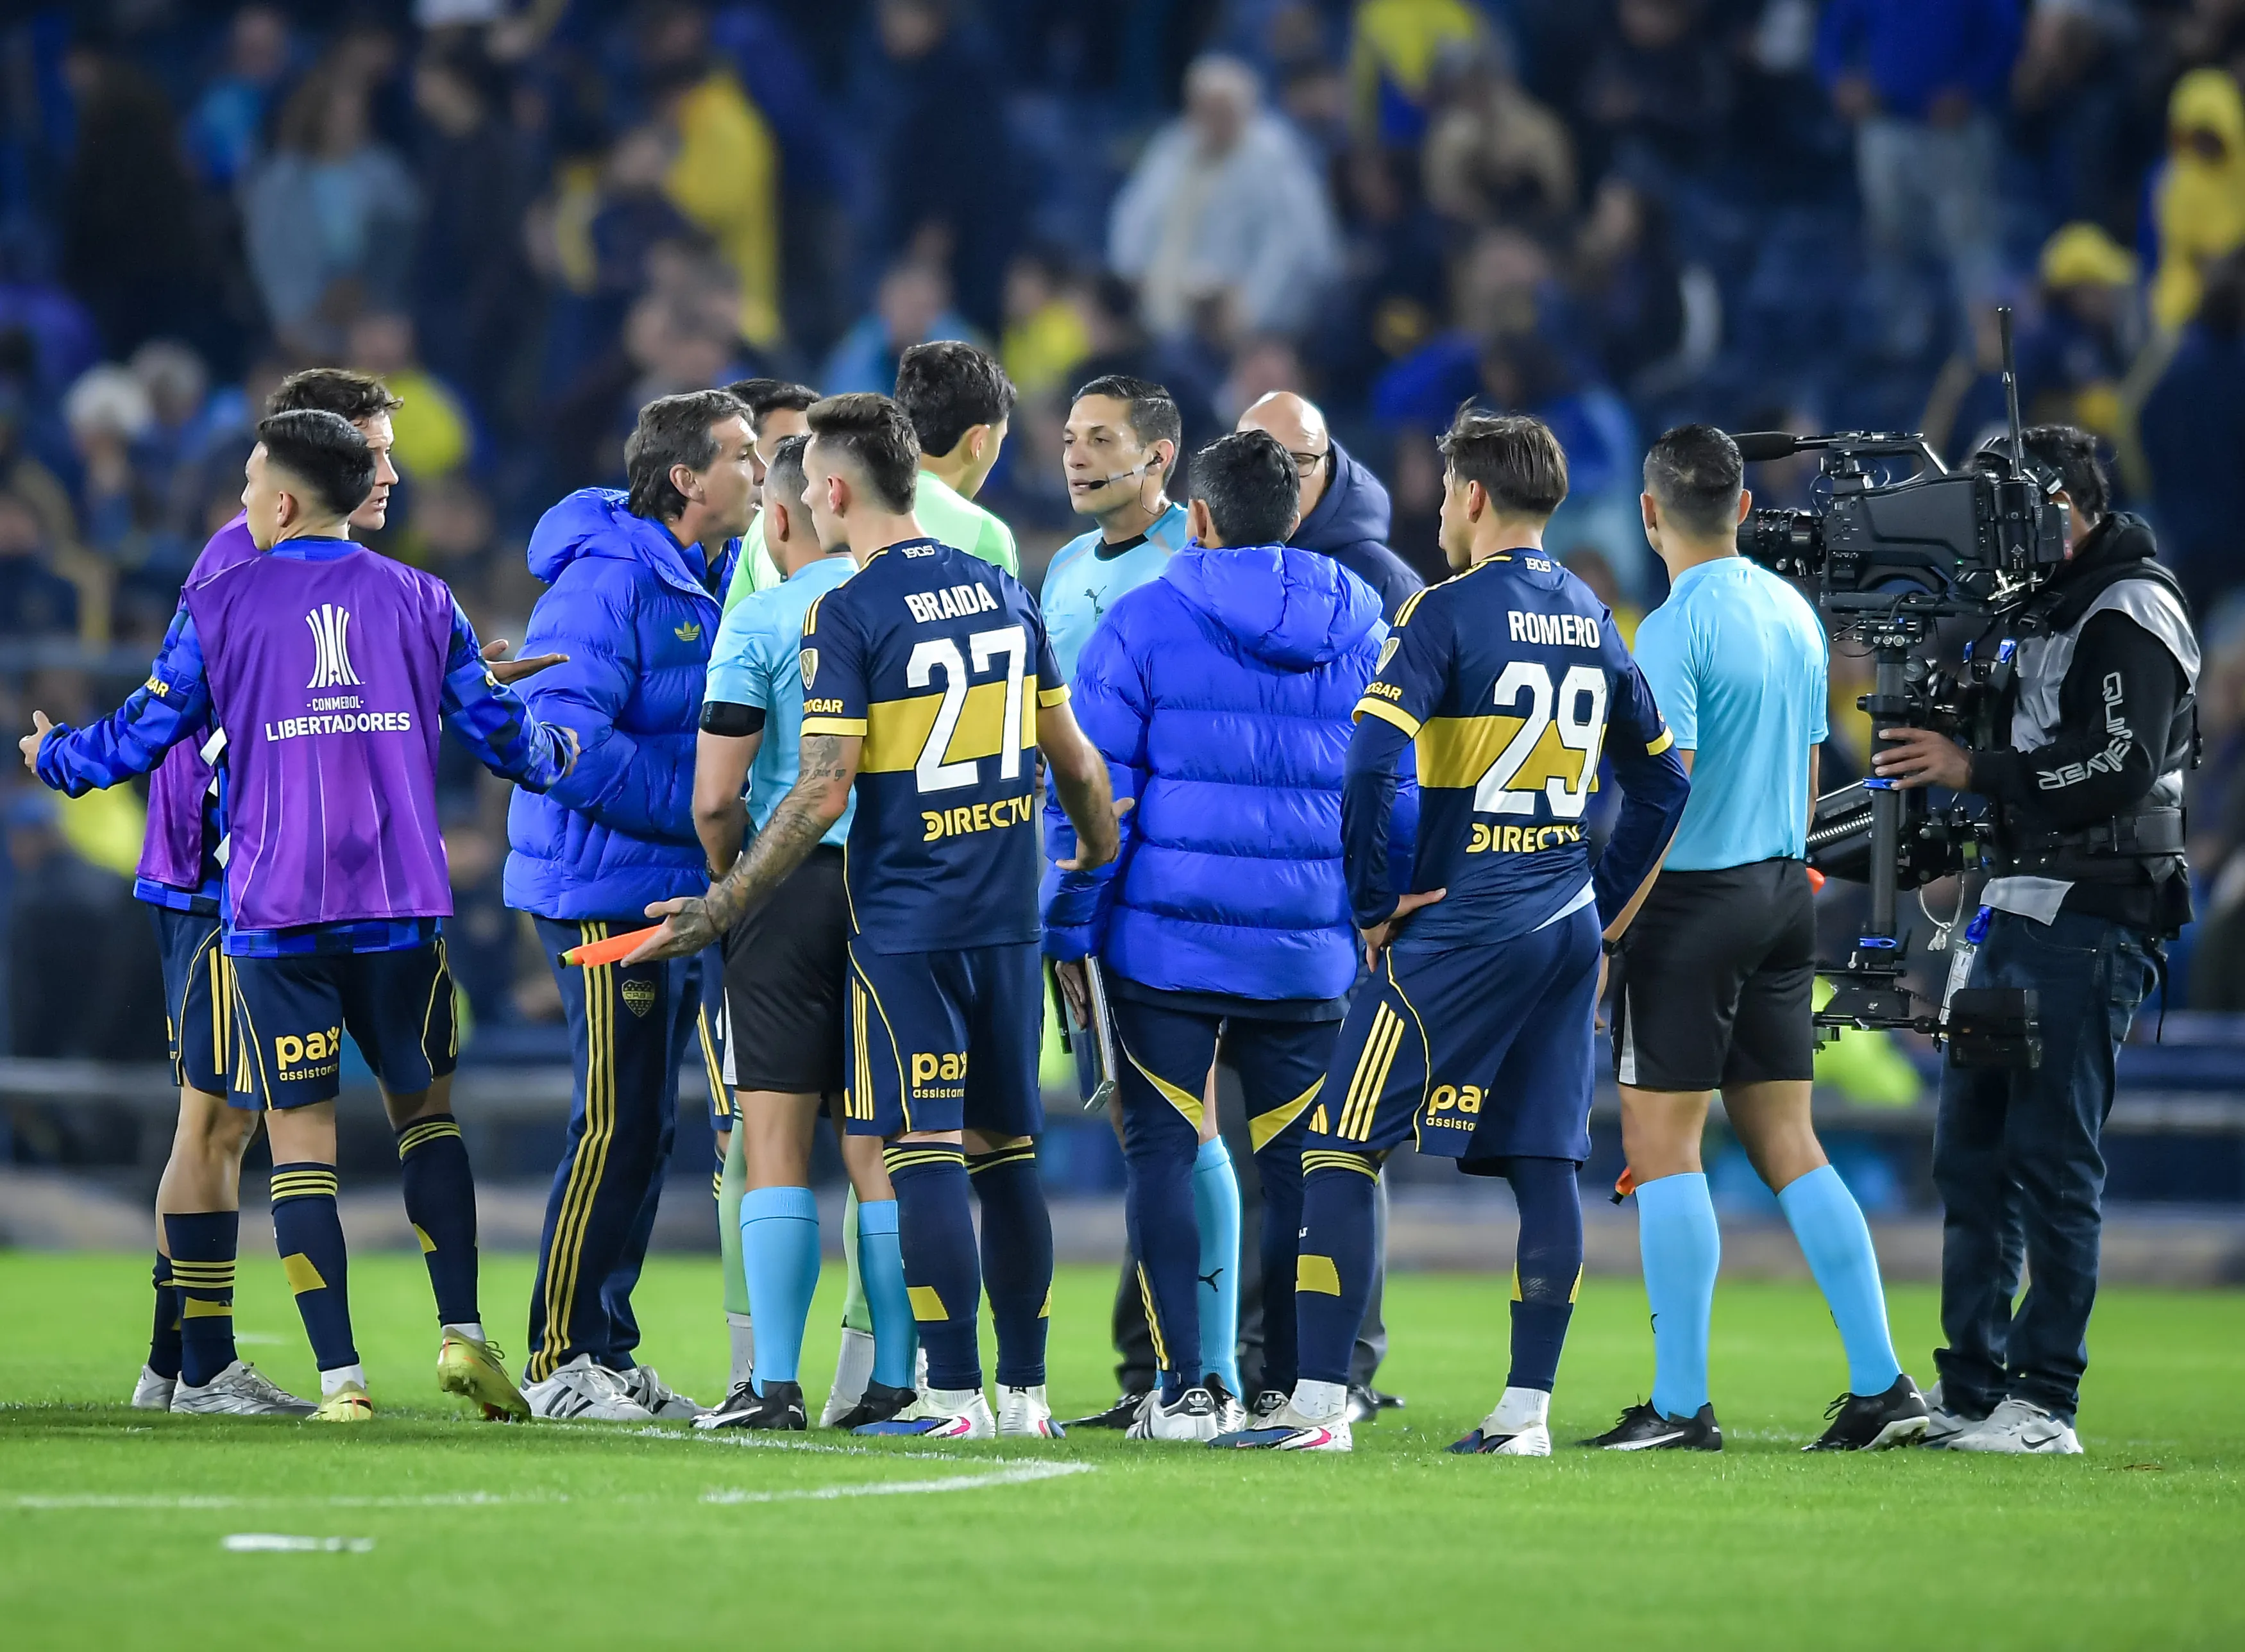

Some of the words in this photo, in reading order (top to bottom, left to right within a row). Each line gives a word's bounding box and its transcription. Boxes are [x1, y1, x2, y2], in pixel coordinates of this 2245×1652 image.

[901, 545, 935, 559] 1905
[1525, 557, 1551, 573] 1905
[904, 582, 999, 623] BRAIDA
[1507, 611, 1600, 648] ROMERO
[265, 712, 411, 741] LIBERTADORES
[906, 625, 1026, 793] 27
[1473, 661, 1607, 818] 29
[921, 794, 1032, 841] DIRECTV
[1466, 823, 1580, 853] DIRECTV
[275, 1026, 339, 1070] pax
[1427, 1084, 1489, 1116] pa
